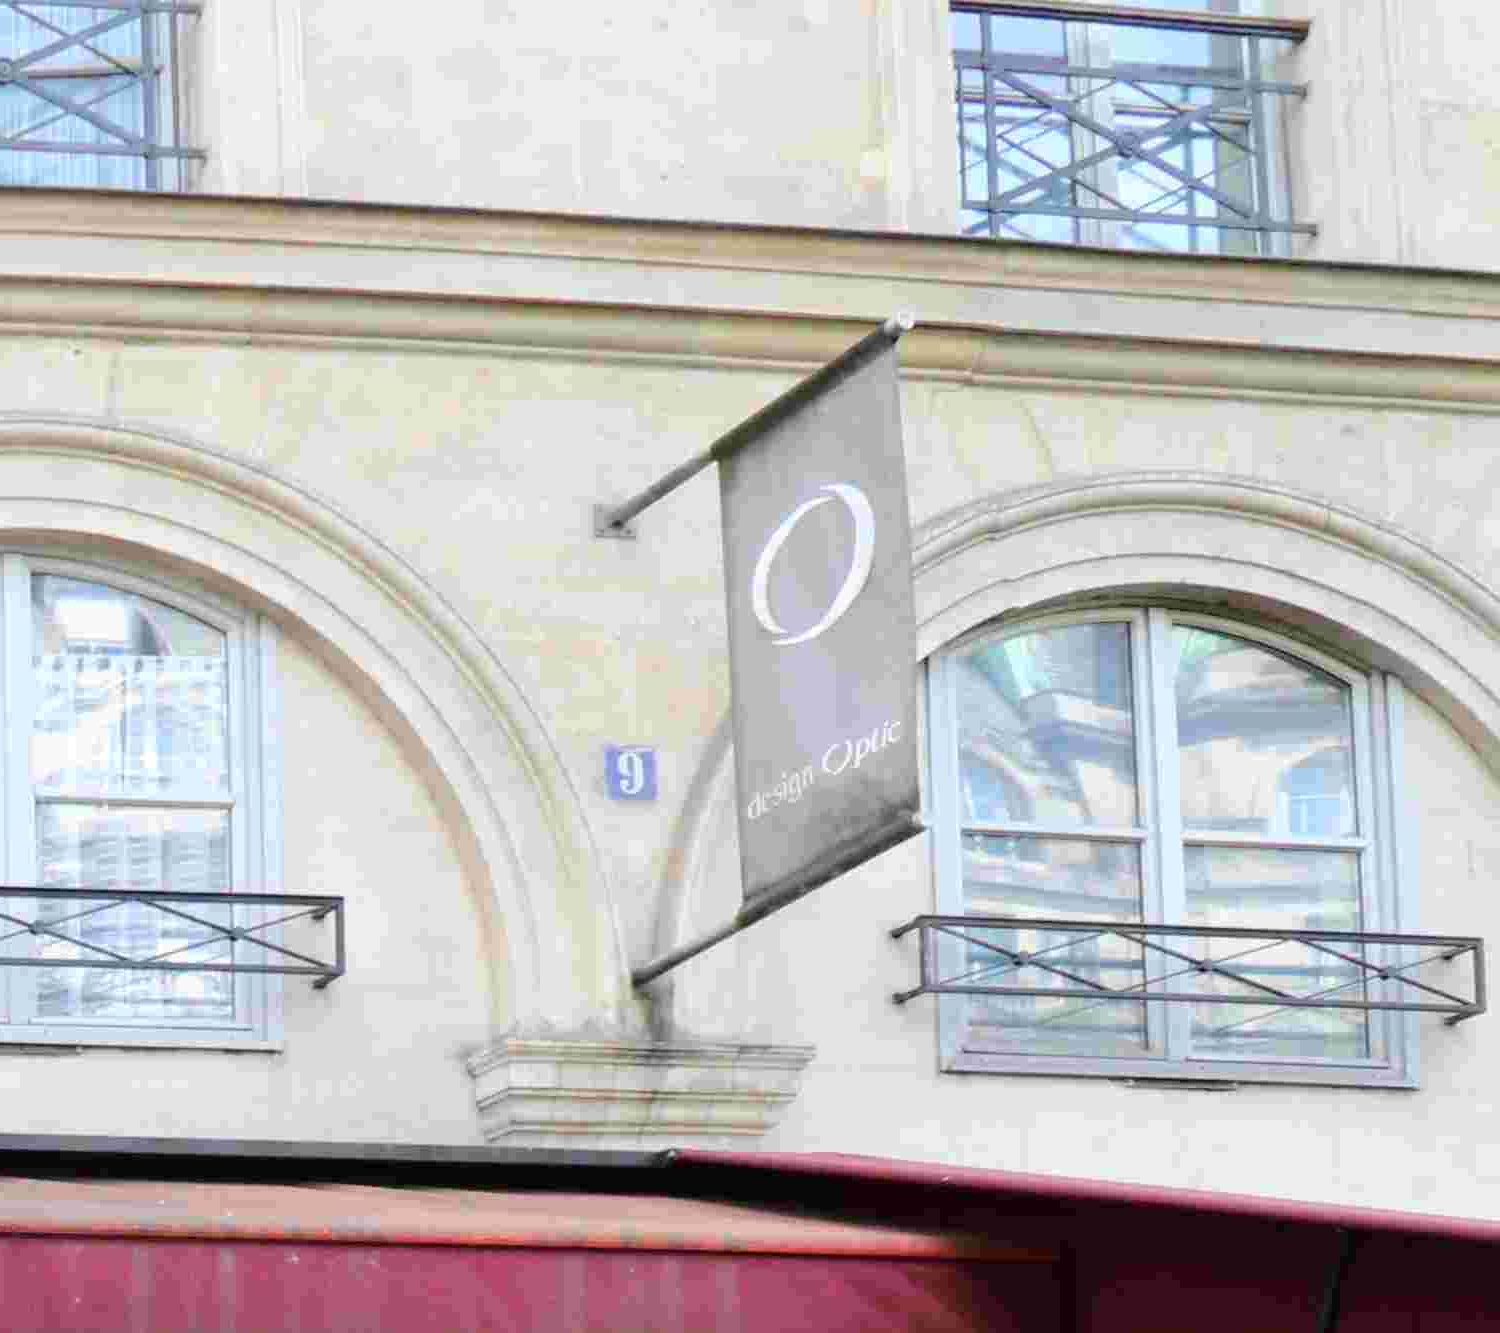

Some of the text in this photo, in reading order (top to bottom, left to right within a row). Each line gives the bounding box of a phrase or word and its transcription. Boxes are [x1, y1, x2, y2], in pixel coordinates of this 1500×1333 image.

[617, 750, 645, 794] 9
[748, 718, 901, 820] design Optic
